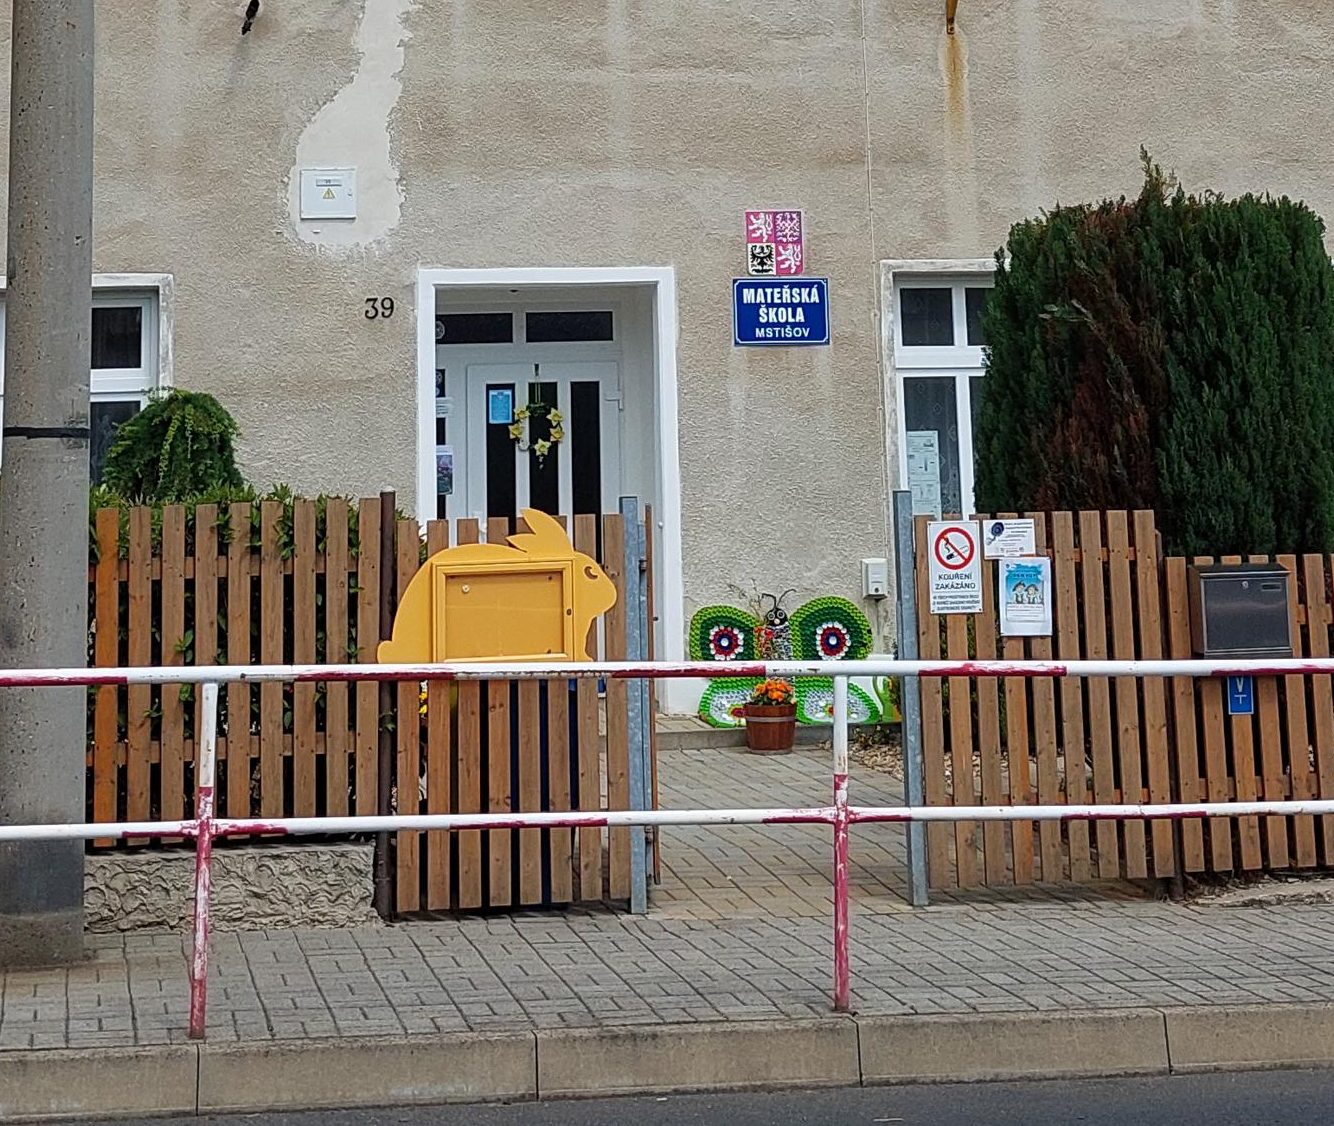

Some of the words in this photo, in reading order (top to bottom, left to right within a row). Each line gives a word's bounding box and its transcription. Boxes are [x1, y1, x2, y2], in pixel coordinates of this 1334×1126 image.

[743, 285, 820, 304] MATEŘSKÁ
[364, 297, 395, 320] 39
[758, 304, 805, 323] ŠKOLA
[755, 327, 810, 338] MSTIŠOV
[938, 572, 973, 581] KOUŘENÍ
[935, 582, 976, 590] ZAKÁZÁNO
